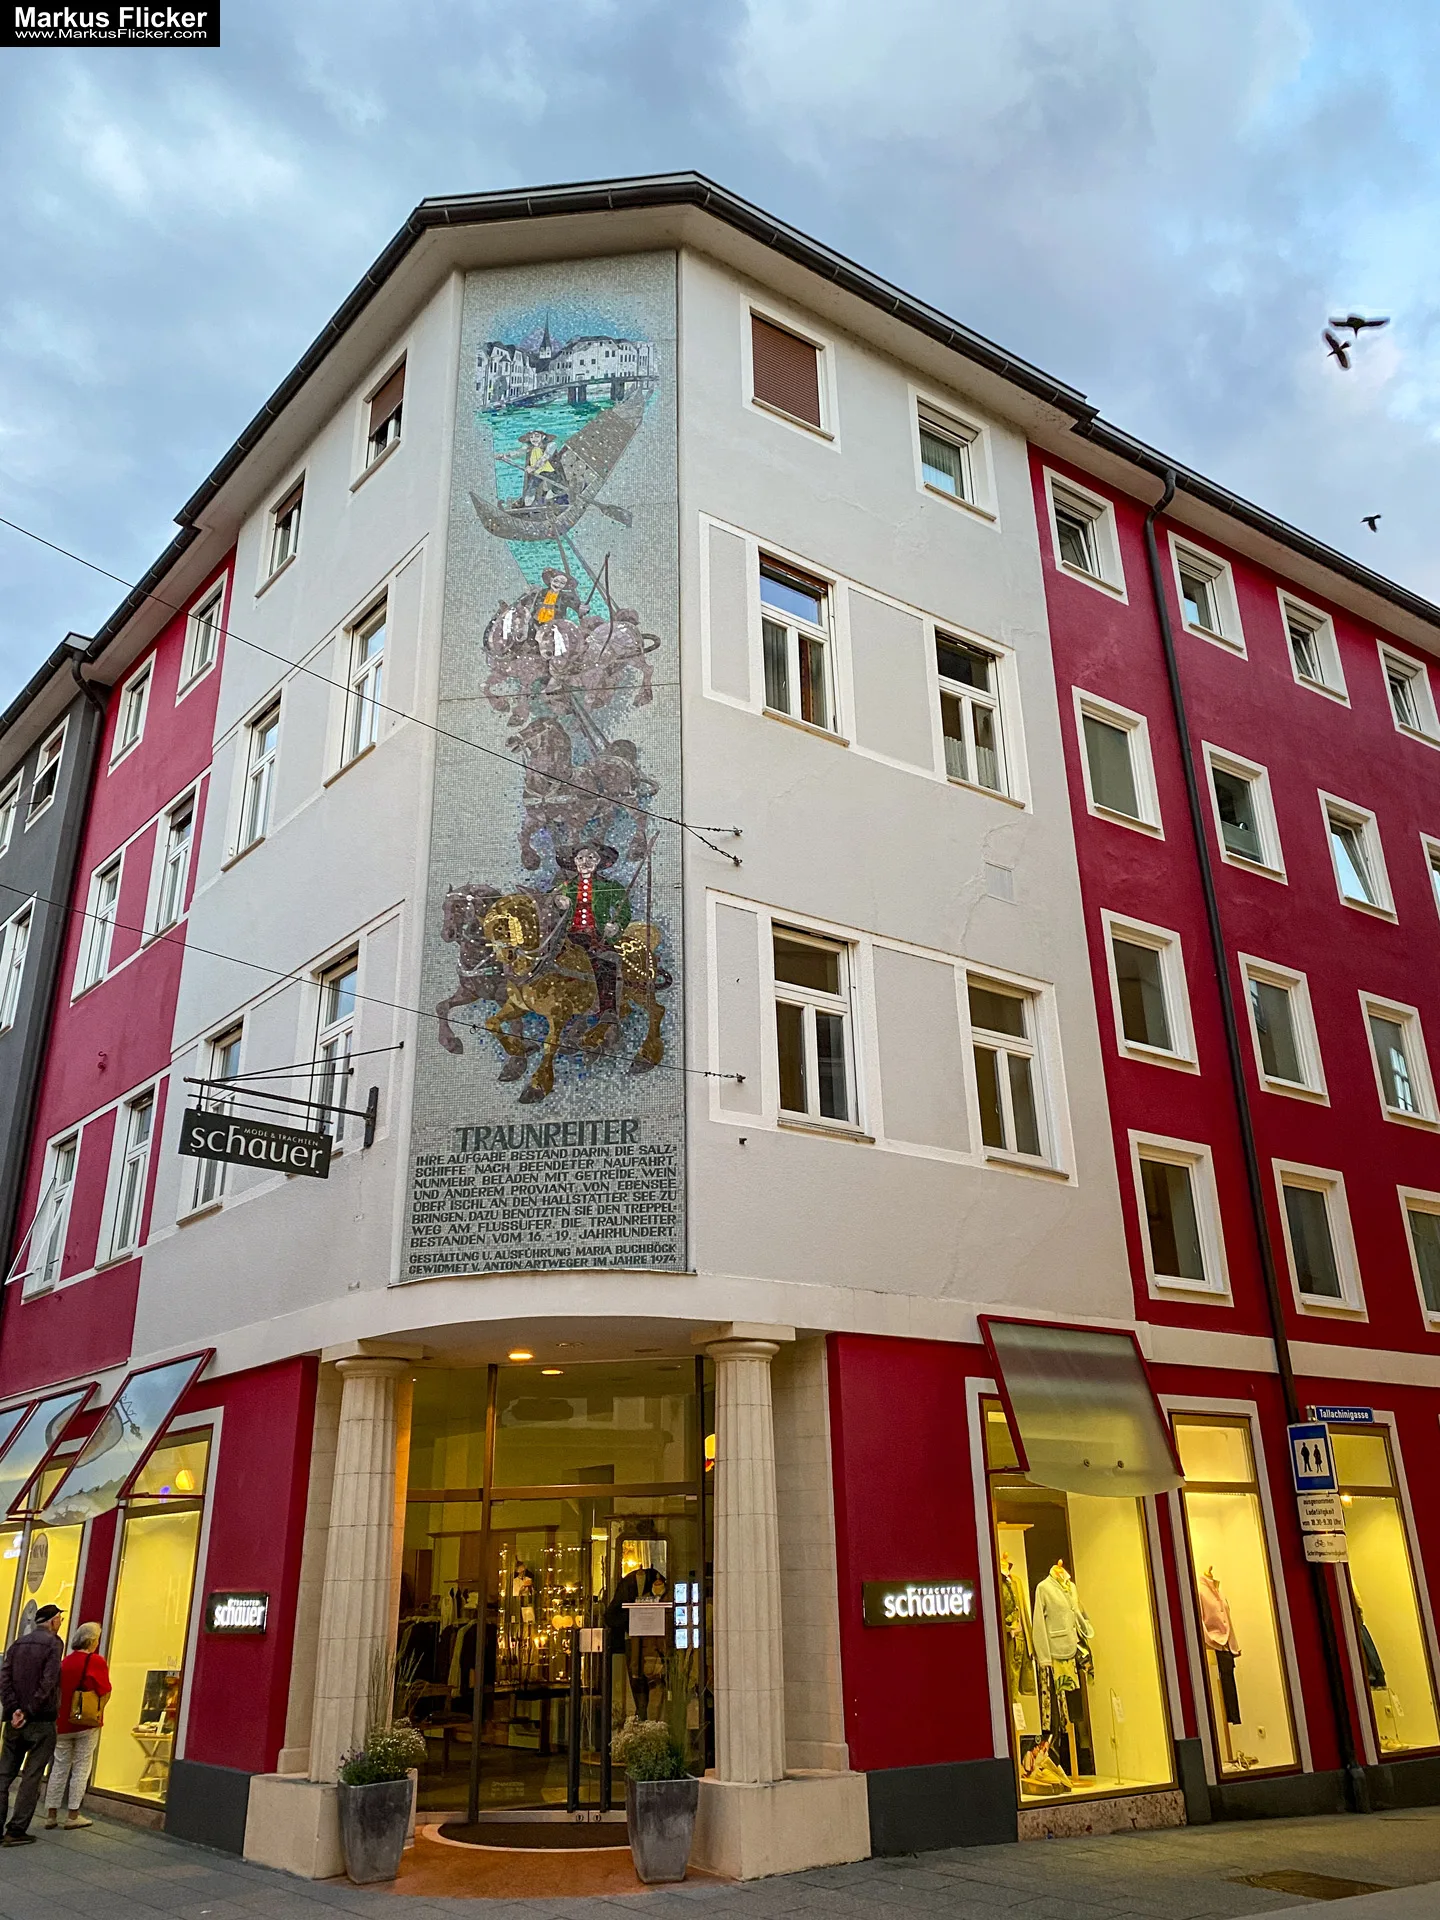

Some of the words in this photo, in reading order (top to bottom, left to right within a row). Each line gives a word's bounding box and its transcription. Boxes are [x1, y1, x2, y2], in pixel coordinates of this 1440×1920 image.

[243, 1127, 268, 1138] MODE
[278, 1133, 319, 1147] TRACHTEN
[456, 1119, 639, 1152] TRAUNREITER
[190, 1125, 323, 1169] schauer
[416, 1154, 444, 1166] IHRE
[447, 1152, 506, 1164] AUFGABE
[510, 1148, 568, 1161] BESTAND
[615, 1145, 634, 1156] DIE
[414, 1176, 475, 1189] NUNMEHR
[482, 1173, 538, 1185] BELADEN
[545, 1171, 569, 1182] MIT
[641, 1167, 676, 1178] WEIN
[415, 1165, 466, 1178] SCHIFFE
[475, 1163, 510, 1174] NACH
[519, 1159, 594, 1172] BEENDETER
[413, 1189, 439, 1200] UND
[444, 1185, 504, 1199] ANDEREM
[583, 1181, 610, 1192] VON
[617, 1178, 676, 1191] EBENSEE
[450, 1198, 485, 1211] ISCHL
[489, 1198, 507, 1209] AN
[512, 1196, 537, 1207] DEN
[543, 1192, 627, 1206] HALLSTÄTTER
[632, 1191, 656, 1202] SEE
[660, 1190, 677, 1201] ZU
[412, 1211, 466, 1224] BRINGEN.
[469, 1210, 499, 1221] DAZU
[502, 1206, 571, 1220] BENÜTZTEN
[574, 1205, 593, 1216] SIE
[597, 1204, 620, 1215] DEN
[412, 1224, 442, 1236] WEG
[447, 1223, 470, 1234] AM
[478, 1219, 555, 1233] FLUSSUFER.
[561, 1217, 581, 1228] DIE
[589, 1214, 676, 1227] TRAUNREITER
[410, 1234, 486, 1248] BESTANDEN
[492, 1232, 521, 1244] VOM
[579, 1226, 677, 1240] JAHRHUNDERT.
[409, 1251, 479, 1264] GESTALTUNG
[482, 1251, 492, 1260] U.
[494, 1247, 571, 1260] AUSFÜHRUNG
[575, 1245, 612, 1256] MARIA
[615, 1242, 676, 1255] BUCHBÖCK
[408, 1262, 469, 1275] GEWIDMET
[471, 1261, 480, 1272] V.
[482, 1260, 521, 1272] ANTON
[524, 1257, 588, 1270] ARTWEGER
[593, 1256, 607, 1267] IM
[609, 1255, 648, 1266] JAHRE
[650, 1254, 677, 1265] 1974
[1319, 1408, 1369, 1421] Tallachinigasse
[917, 1586, 963, 1595] TRACHTEN
[214, 1599, 265, 1626] schauer
[884, 1588, 973, 1618] schauer
